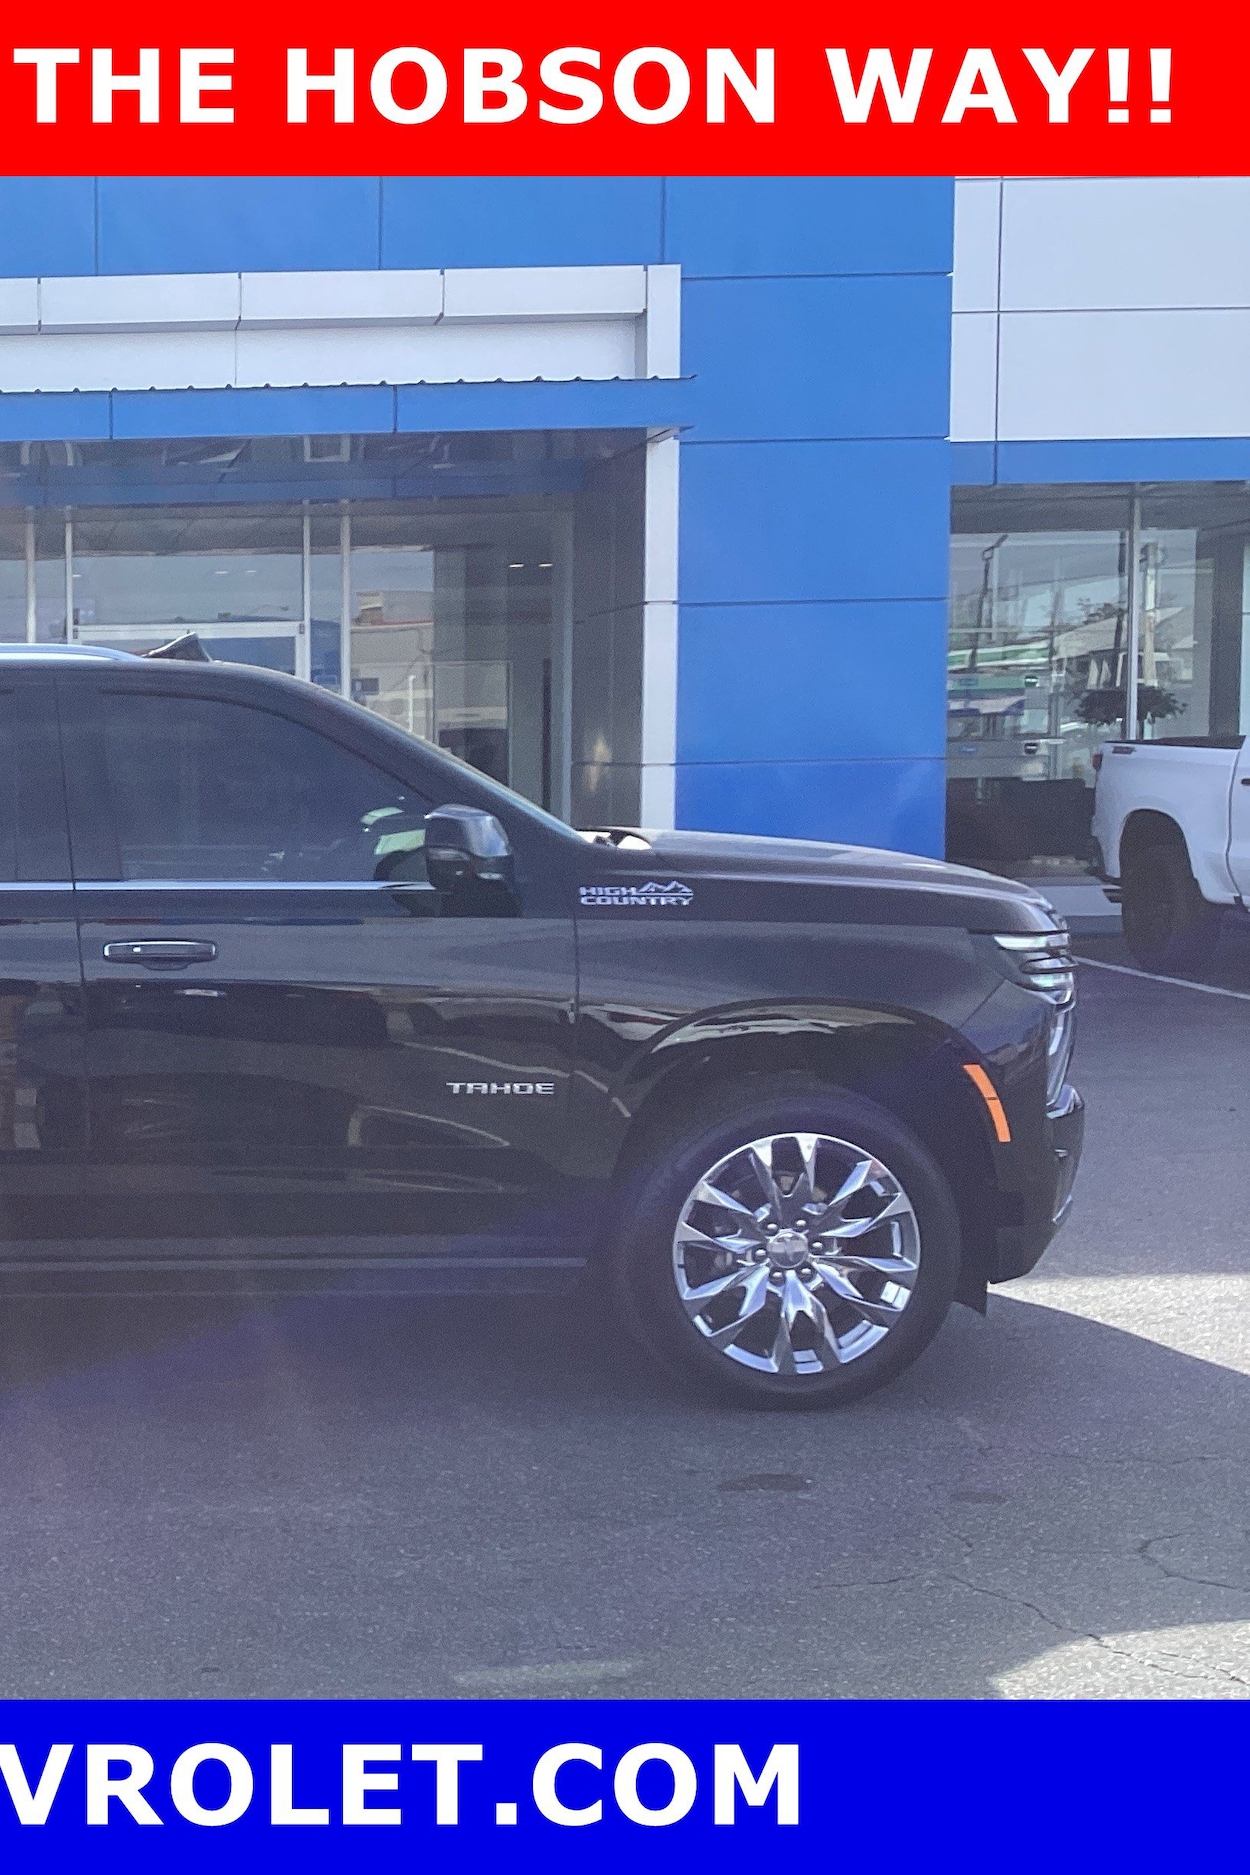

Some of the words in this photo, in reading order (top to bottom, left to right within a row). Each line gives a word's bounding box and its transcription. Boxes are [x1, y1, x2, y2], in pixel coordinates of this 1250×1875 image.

[579, 886, 637, 896] HIGH
[580, 896, 693, 906] COUNTRY
[445, 1082, 555, 1095] TAHOE
